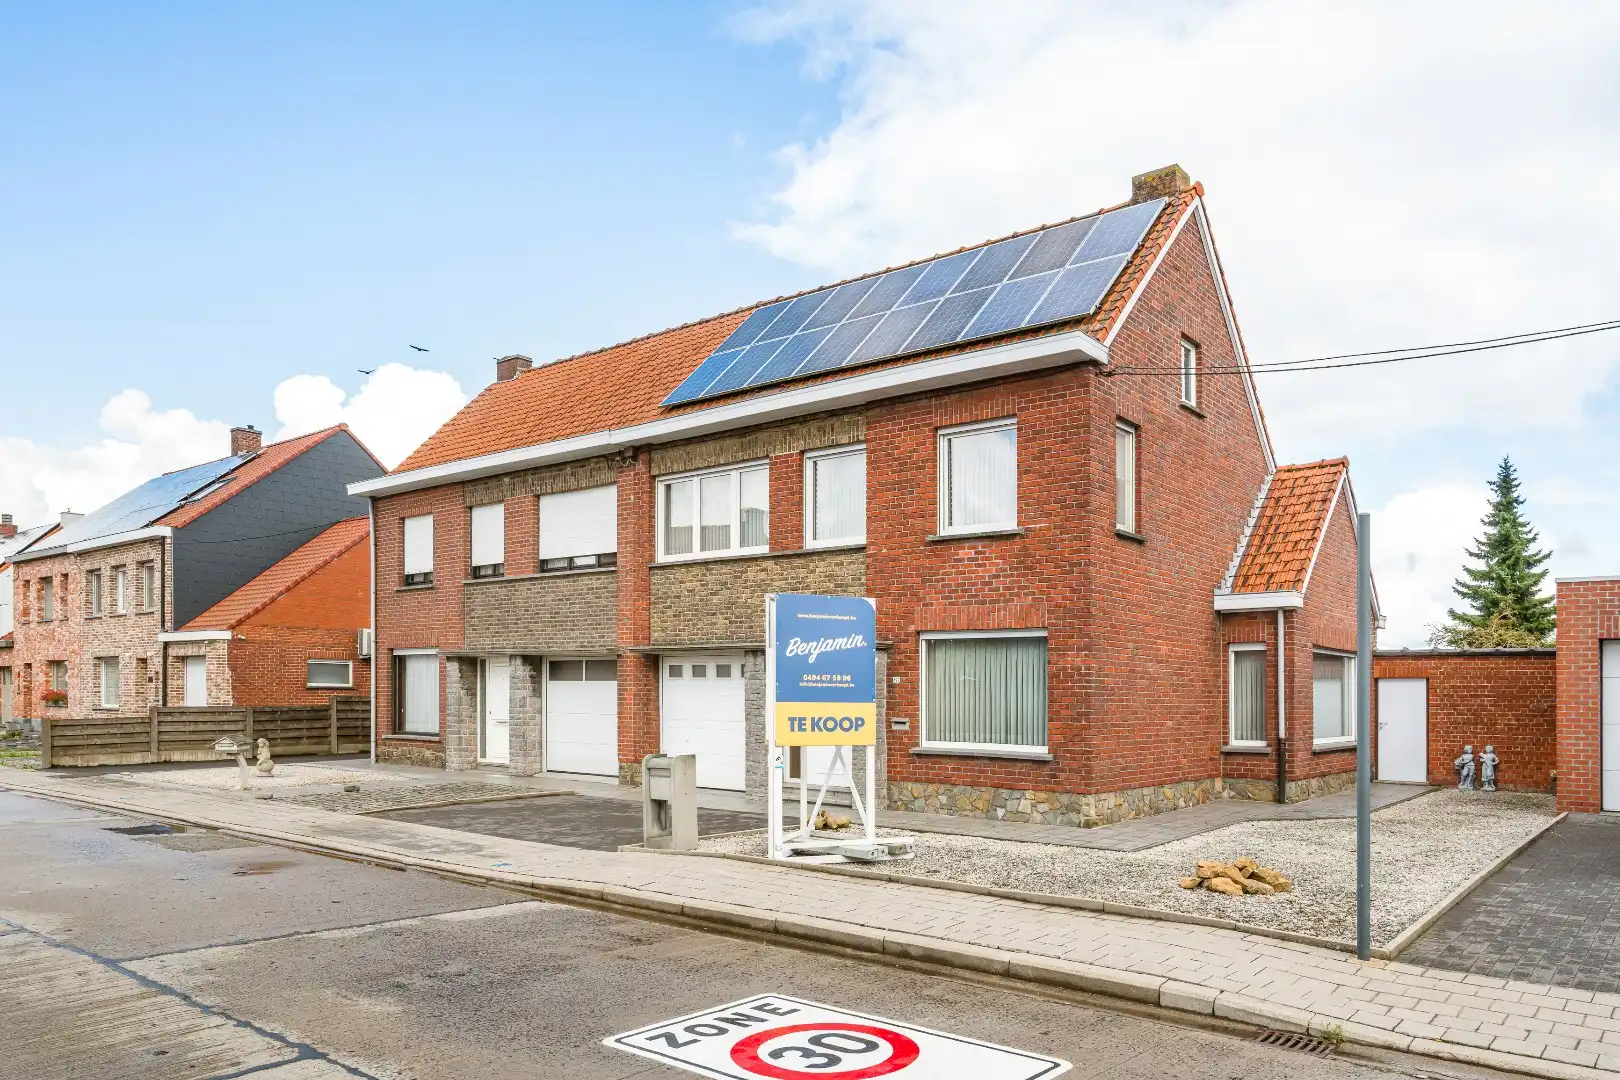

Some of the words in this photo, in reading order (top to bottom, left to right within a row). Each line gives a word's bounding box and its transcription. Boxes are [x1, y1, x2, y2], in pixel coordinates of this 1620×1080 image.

[788, 716, 807, 732] TE
[811, 716, 866, 732] KOOP
[644, 1002, 801, 1049] ZONE
[768, 1032, 880, 1069] 30
